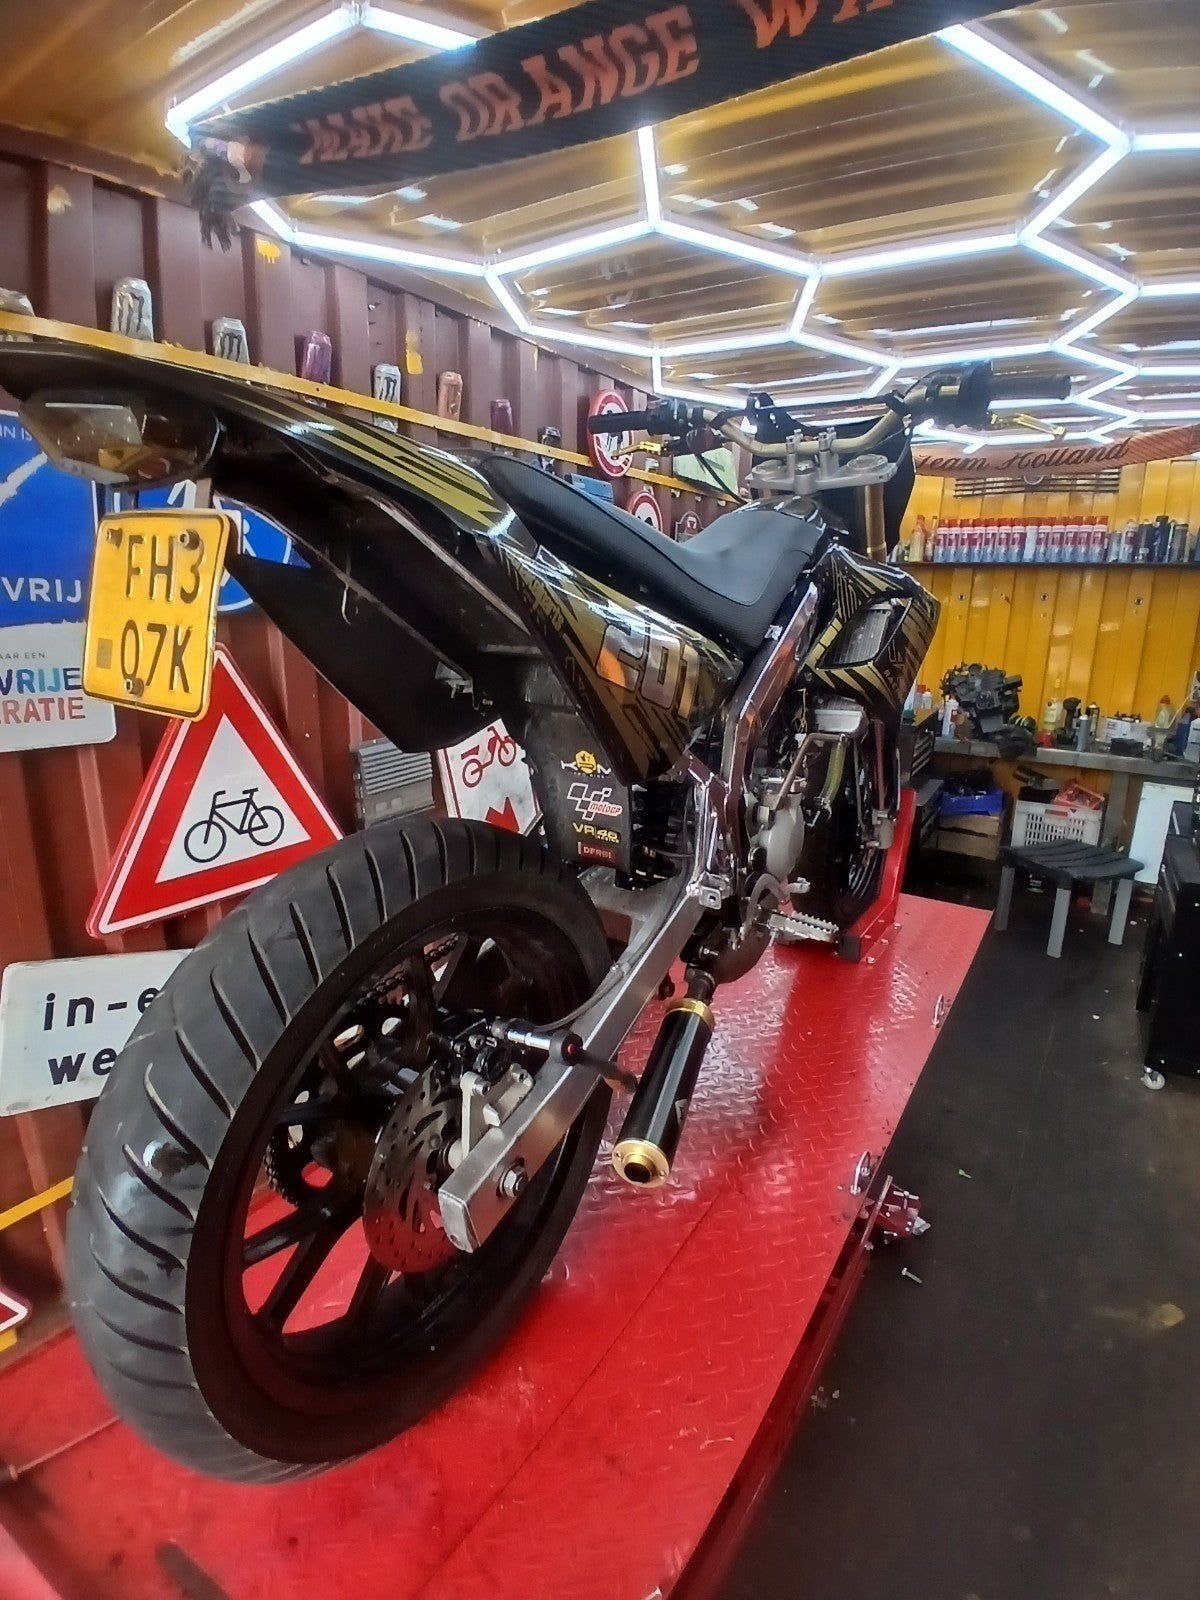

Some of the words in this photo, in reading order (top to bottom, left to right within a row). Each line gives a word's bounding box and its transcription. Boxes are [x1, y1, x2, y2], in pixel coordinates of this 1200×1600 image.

[440, 5, 699, 141] ORANGE
[918, 453, 989, 472] Team
[995, 437, 1130, 471] Holland
[126, 534, 204, 604] FH3
[1, 576, 82, 603] VRIJ
[24, 651, 46, 660] EEN
[120, 620, 193, 694] 07K
[48, 1047, 118, 1085] we
